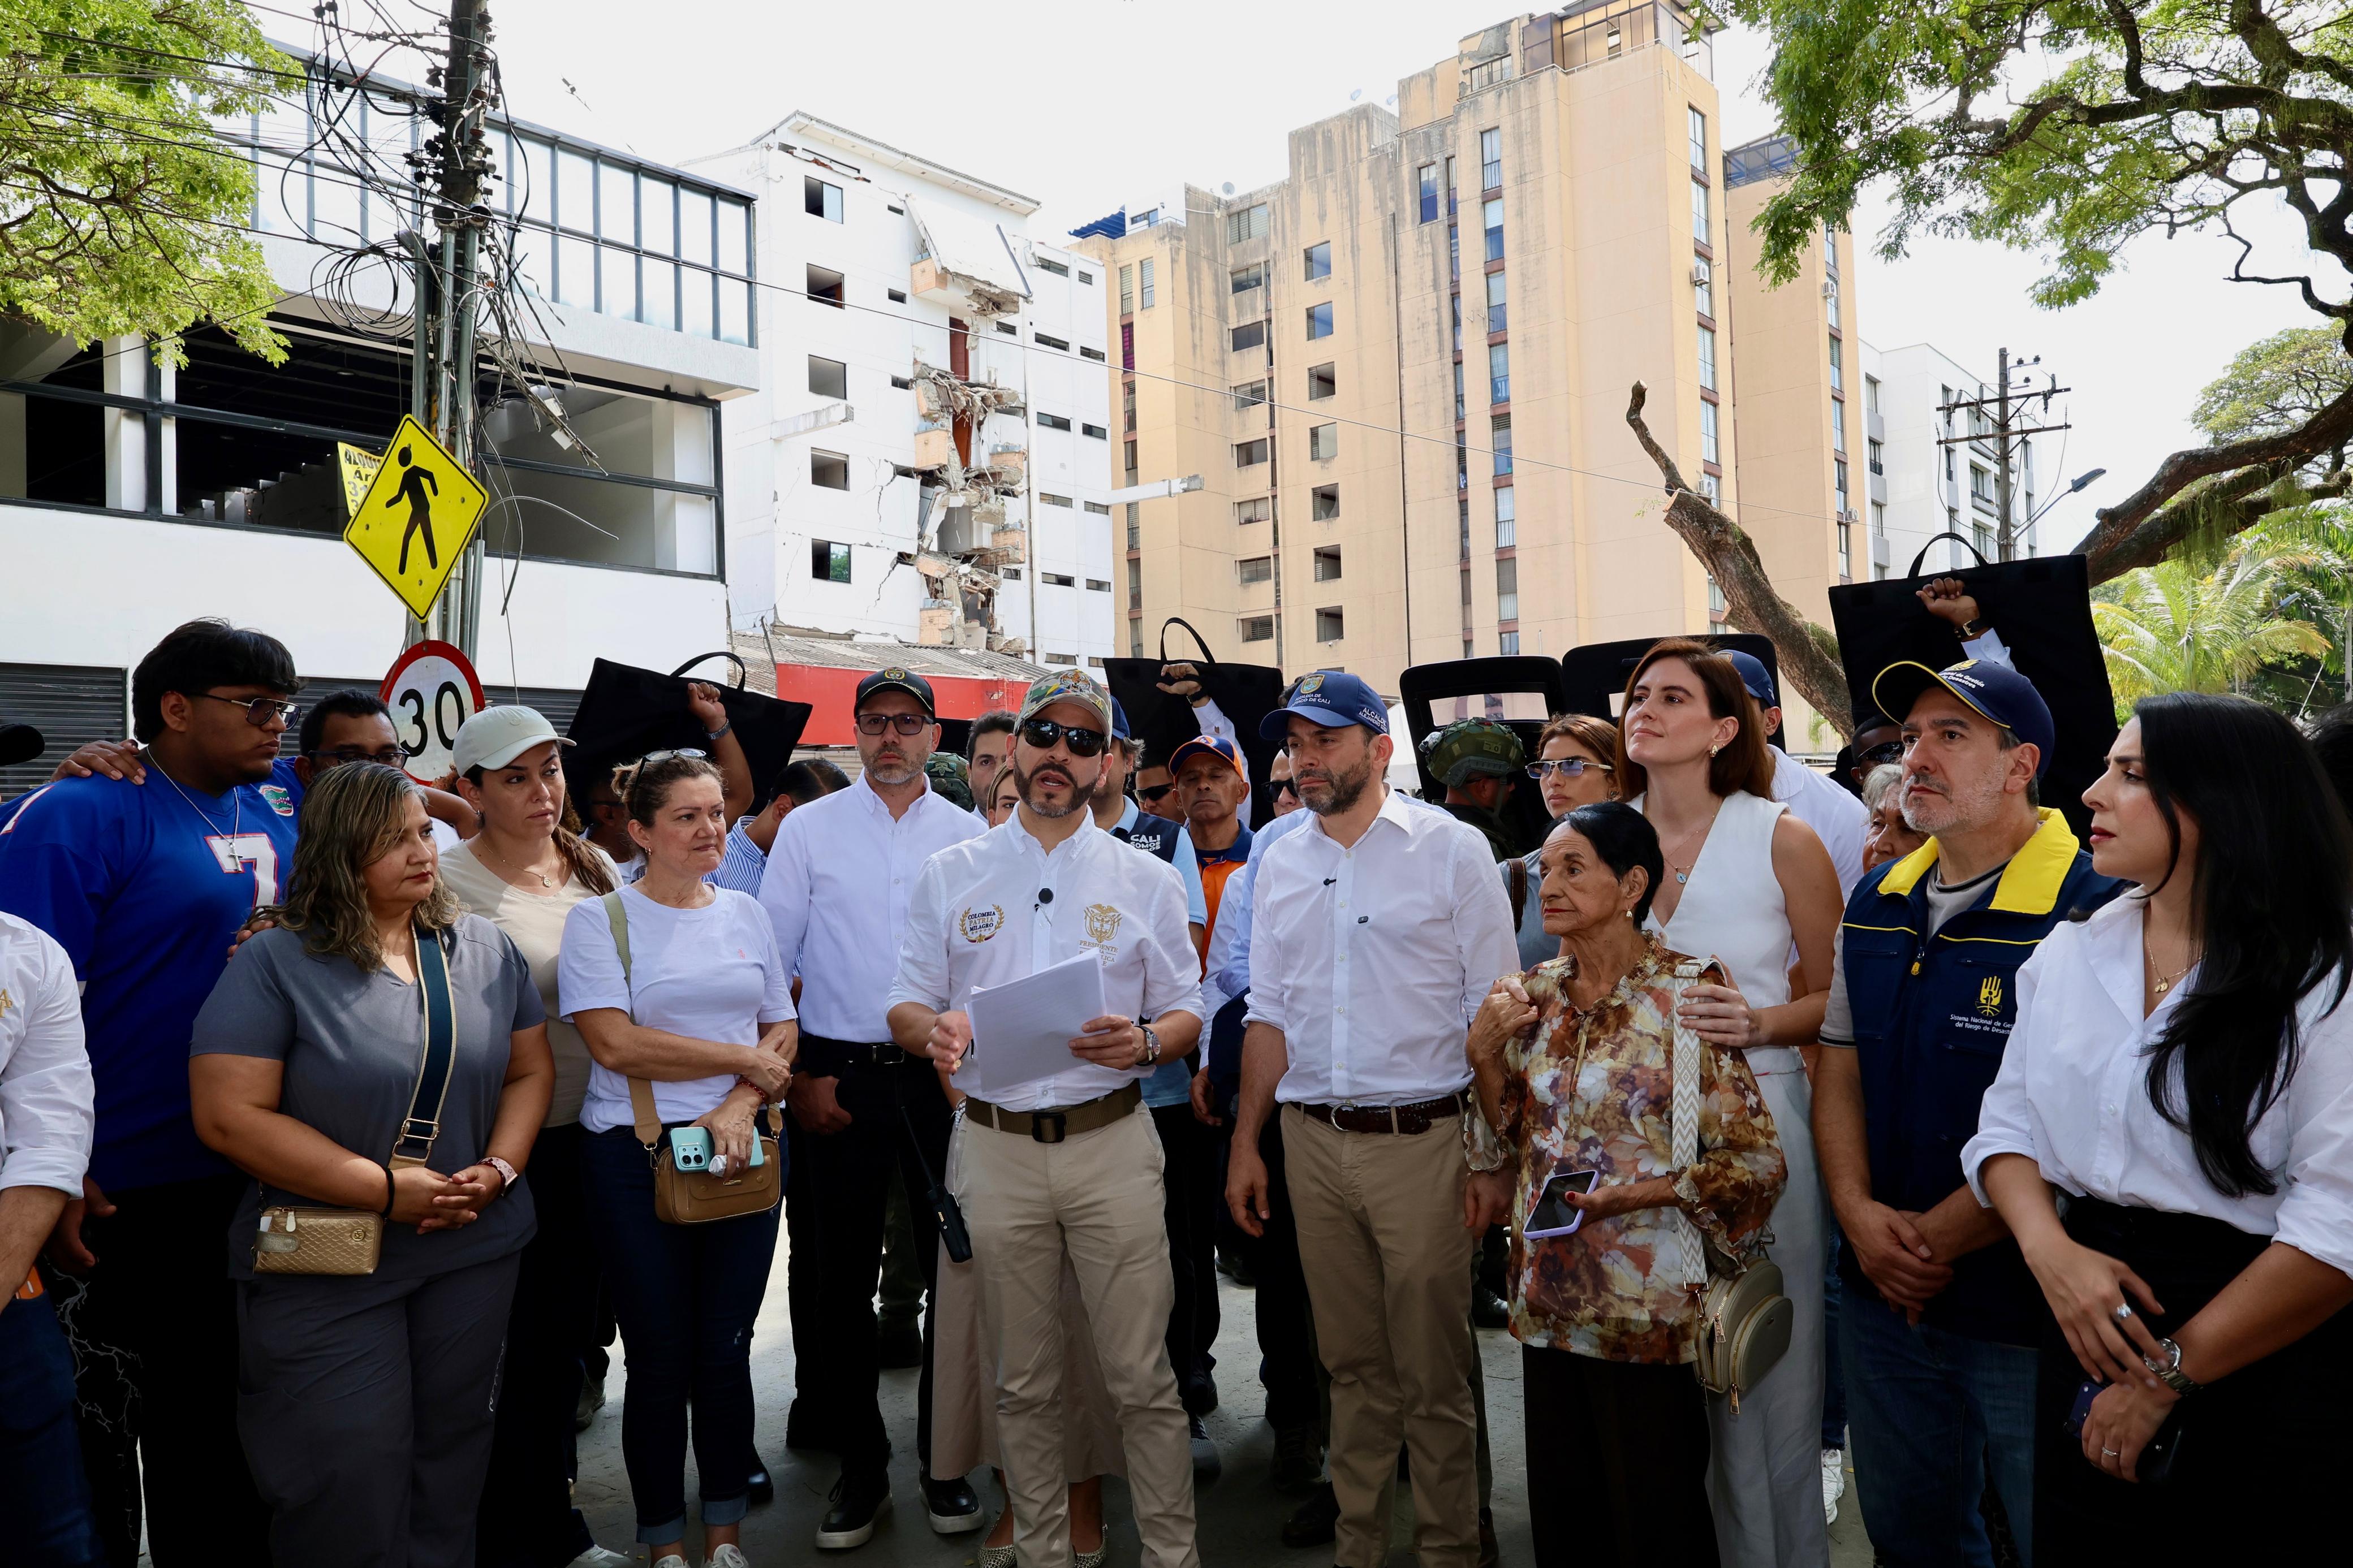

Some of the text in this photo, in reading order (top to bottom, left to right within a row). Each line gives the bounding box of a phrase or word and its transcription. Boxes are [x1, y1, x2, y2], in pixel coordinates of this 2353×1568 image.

[354, 467, 374, 481] Ár
[1948, 676, 1976, 689] Desastres
[399, 681, 465, 757] 30
[1363, 707, 1386, 727] ALCALDE
[1130, 834, 1161, 844] CALI
[968, 911, 996, 920] COLOMBIA
[969, 917, 994, 926] PATRIA
[969, 922, 994, 932] MILAGRO
[1079, 940, 1118, 953] PRESIDENTE
[1971, 1017, 1993, 1025] Nacional
